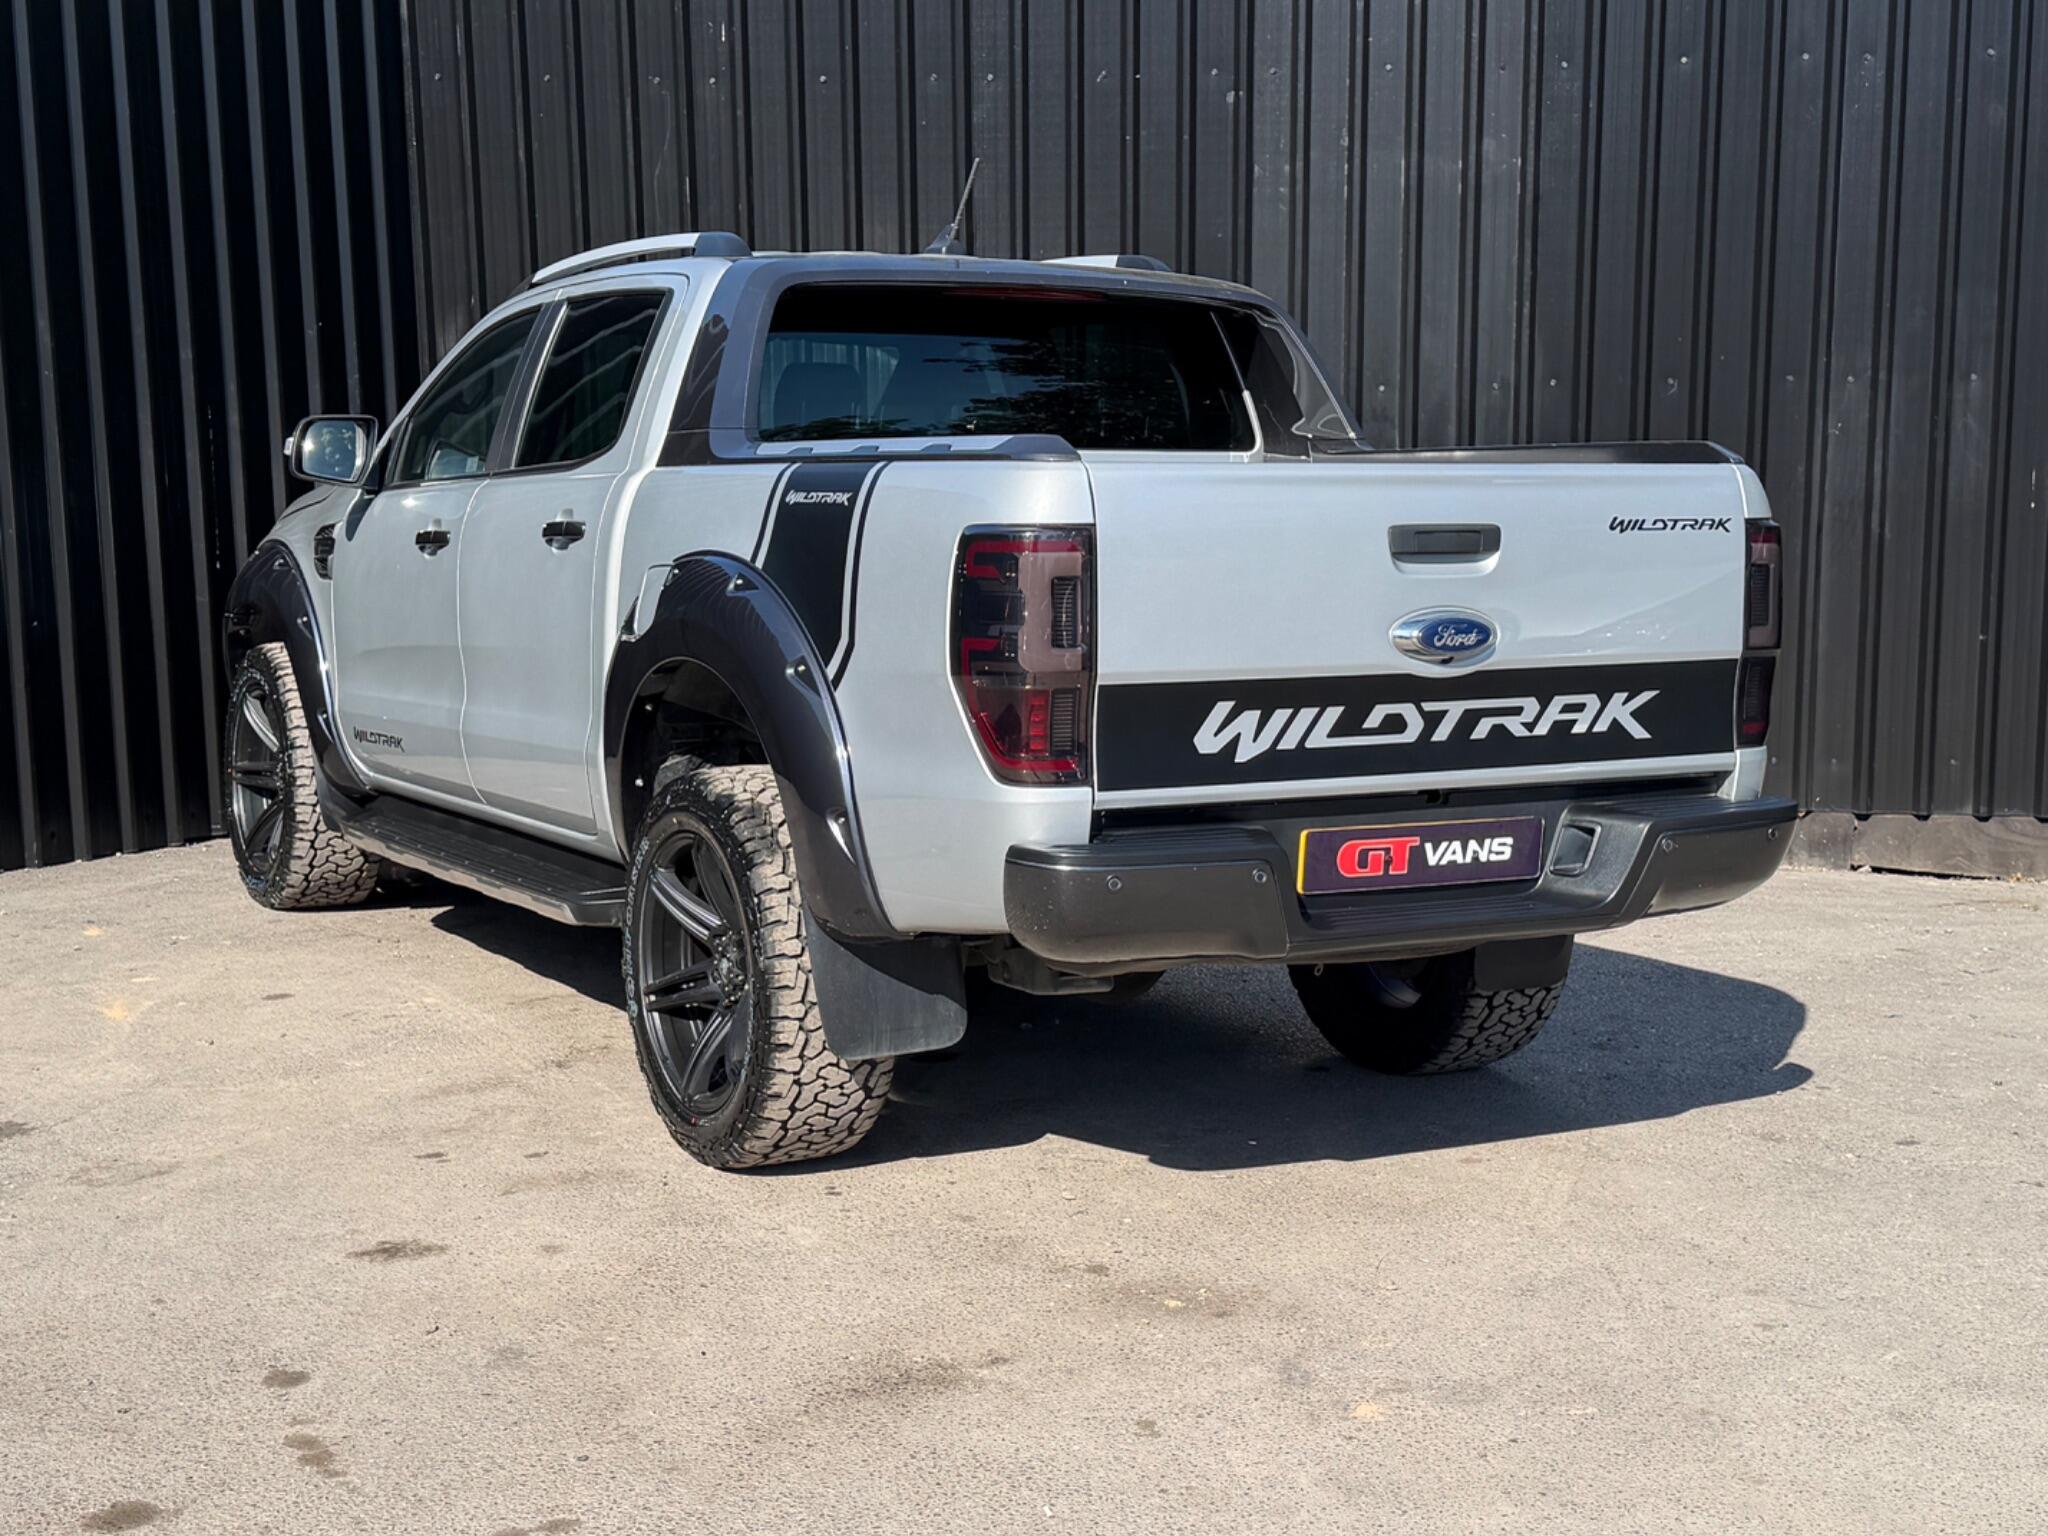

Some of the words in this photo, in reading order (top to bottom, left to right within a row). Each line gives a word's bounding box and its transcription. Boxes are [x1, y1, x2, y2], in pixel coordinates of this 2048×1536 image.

[785, 490, 853, 506] WILDTRAK
[1609, 516, 1732, 534] WILDTRAK
[1433, 623, 1481, 647] Ford
[353, 726, 405, 752] WILDTRAK
[1193, 690, 1660, 763] WILDTRAK
[1336, 836, 1420, 878] GT
[1423, 836, 1514, 867] VANS
